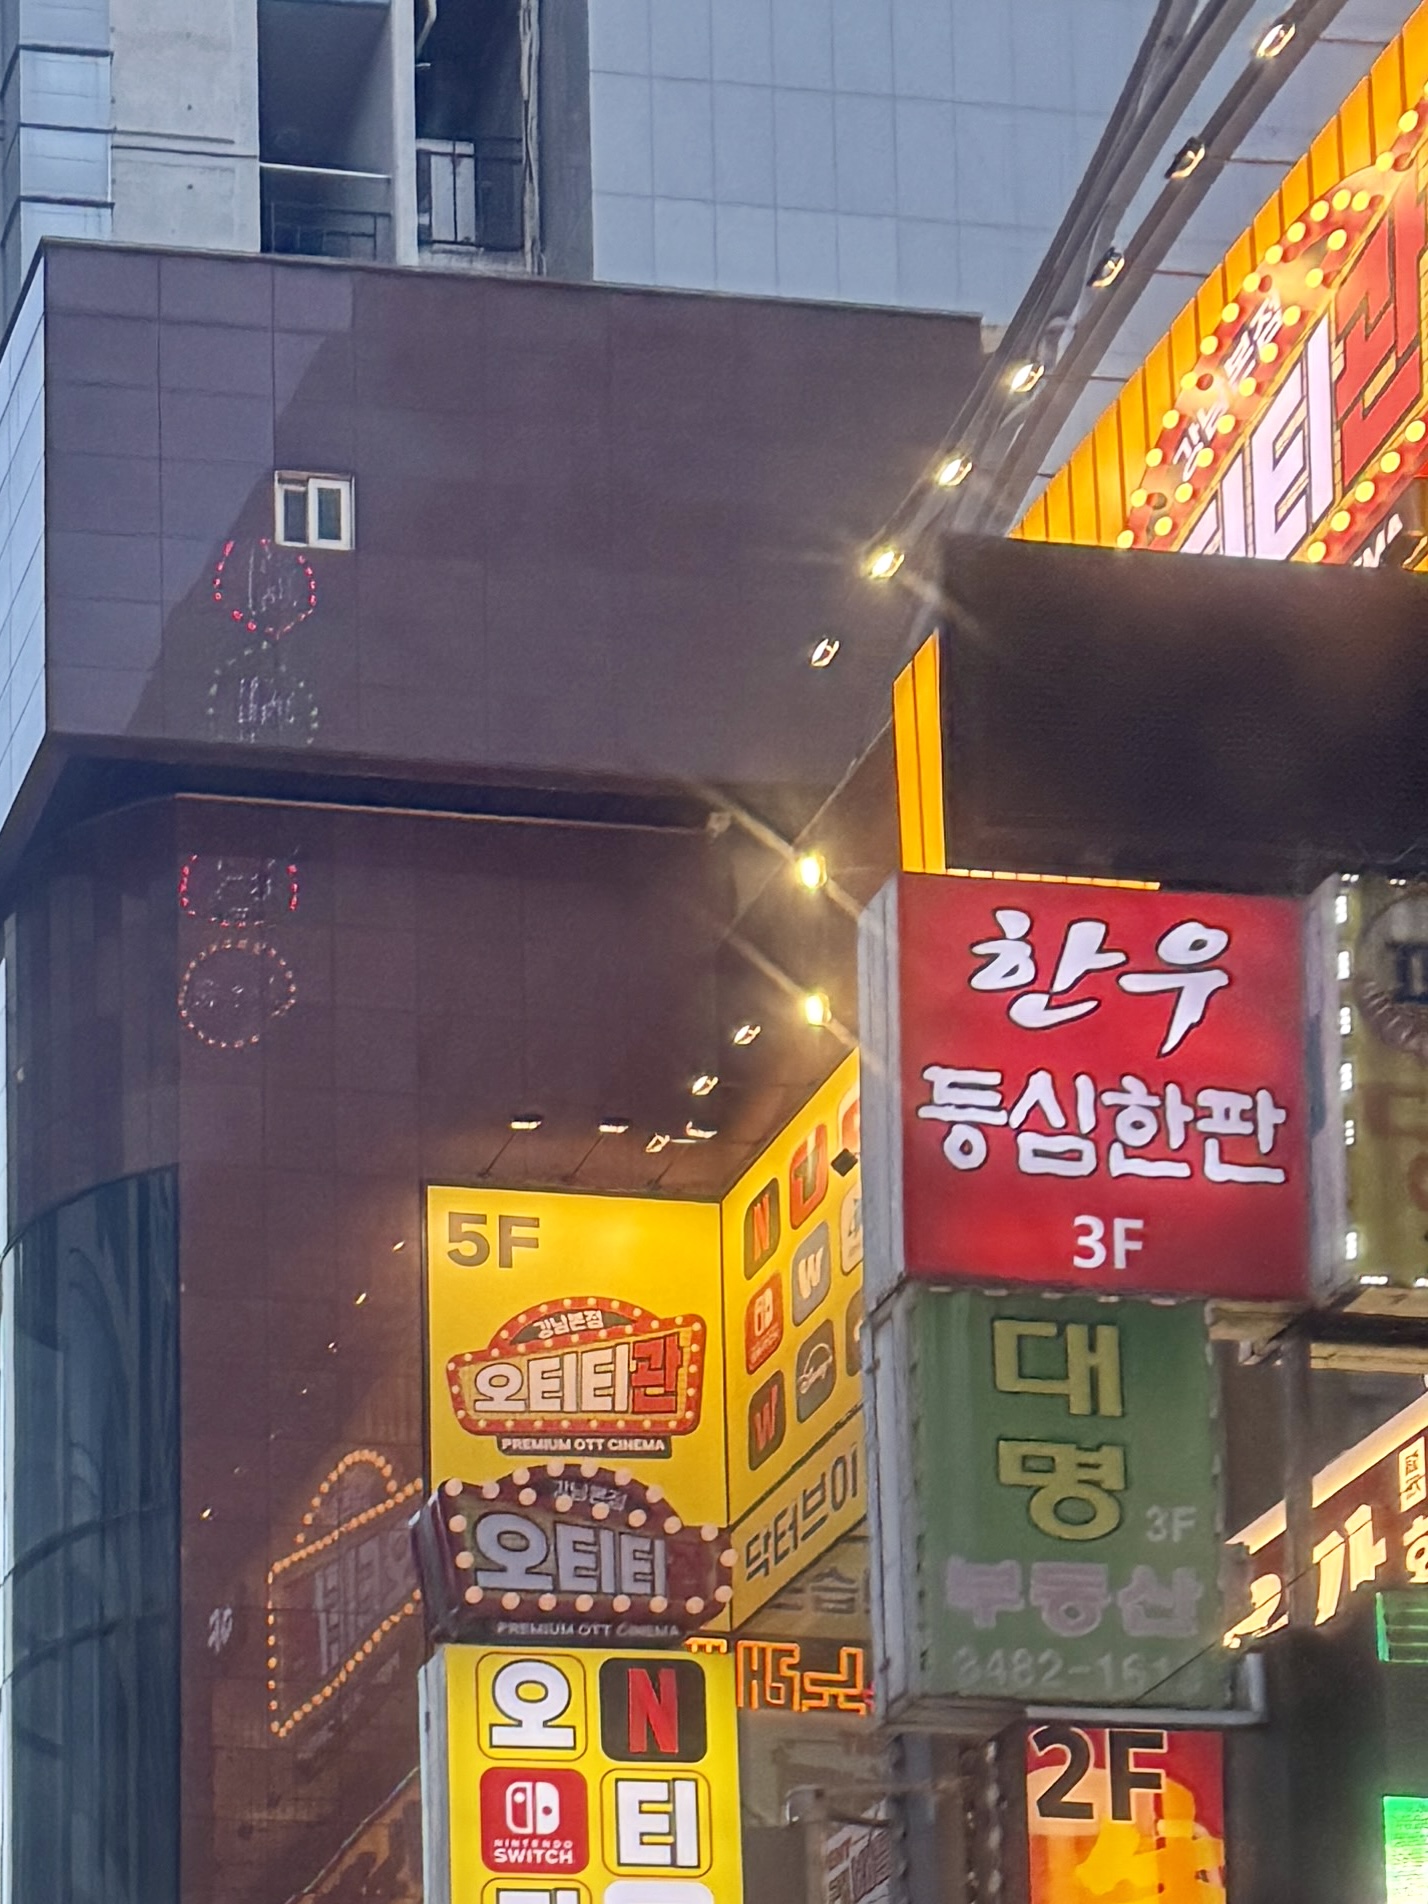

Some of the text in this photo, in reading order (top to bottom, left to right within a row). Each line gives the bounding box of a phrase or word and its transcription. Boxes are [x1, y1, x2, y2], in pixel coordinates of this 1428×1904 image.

[971, 909, 1232, 1056] 한우
[916, 1066, 1288, 1184] 등심한판
[447, 1211, 541, 1269] 5F
[1073, 1215, 1143, 1270] 3F
[474, 1331, 685, 1416] 오티티관
[501, 1436, 666, 1453] PREMIUM OTT CINEMA
[993, 1318, 1127, 1543] 대명
[746, 1443, 860, 1579] 닥터브이
[1146, 1504, 1196, 1543] 3F
[946, 1560, 1200, 1637] 부동산
[490, 1660, 576, 1749] 오
[1030, 1725, 1169, 1822] 2F
[493, 1848, 574, 1866] SWITCH
